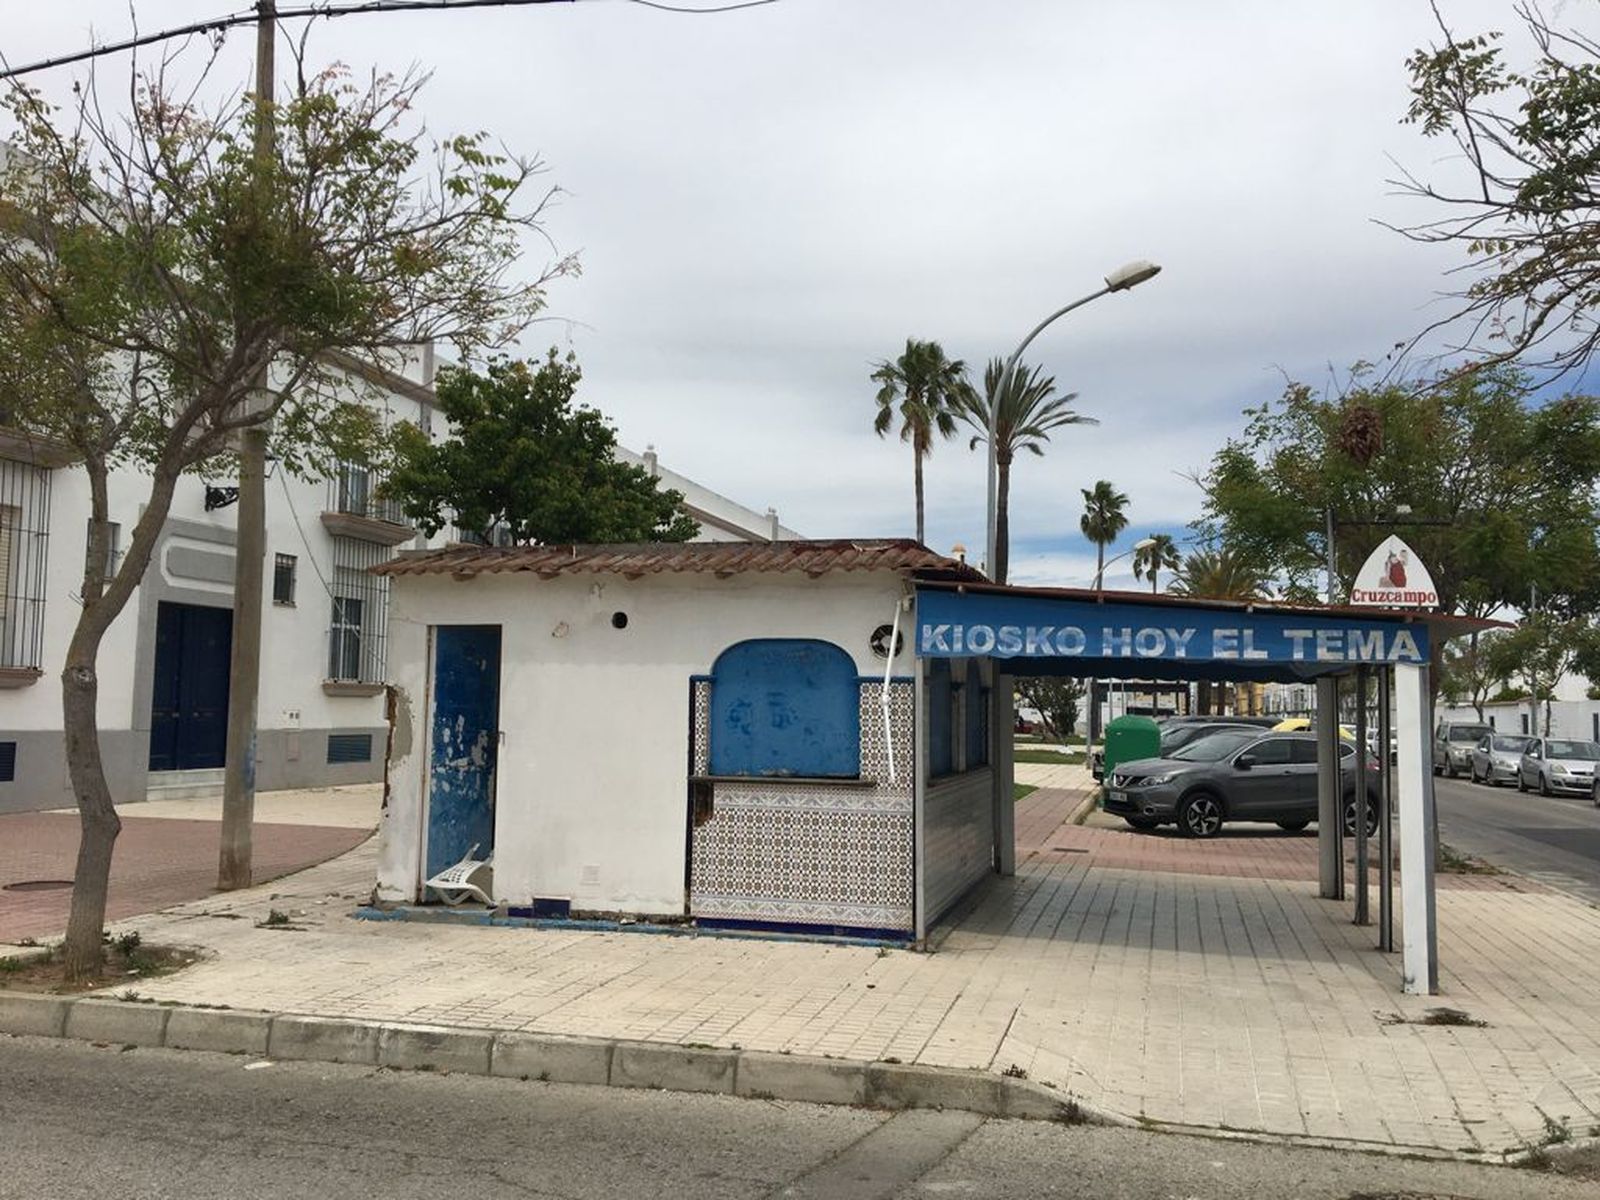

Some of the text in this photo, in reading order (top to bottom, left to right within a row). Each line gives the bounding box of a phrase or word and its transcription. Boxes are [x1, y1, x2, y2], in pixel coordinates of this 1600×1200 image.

[1352, 589, 1436, 606] Cruzcampo
[921, 624, 1422, 661] KIOSKO HOY EL TEMA
